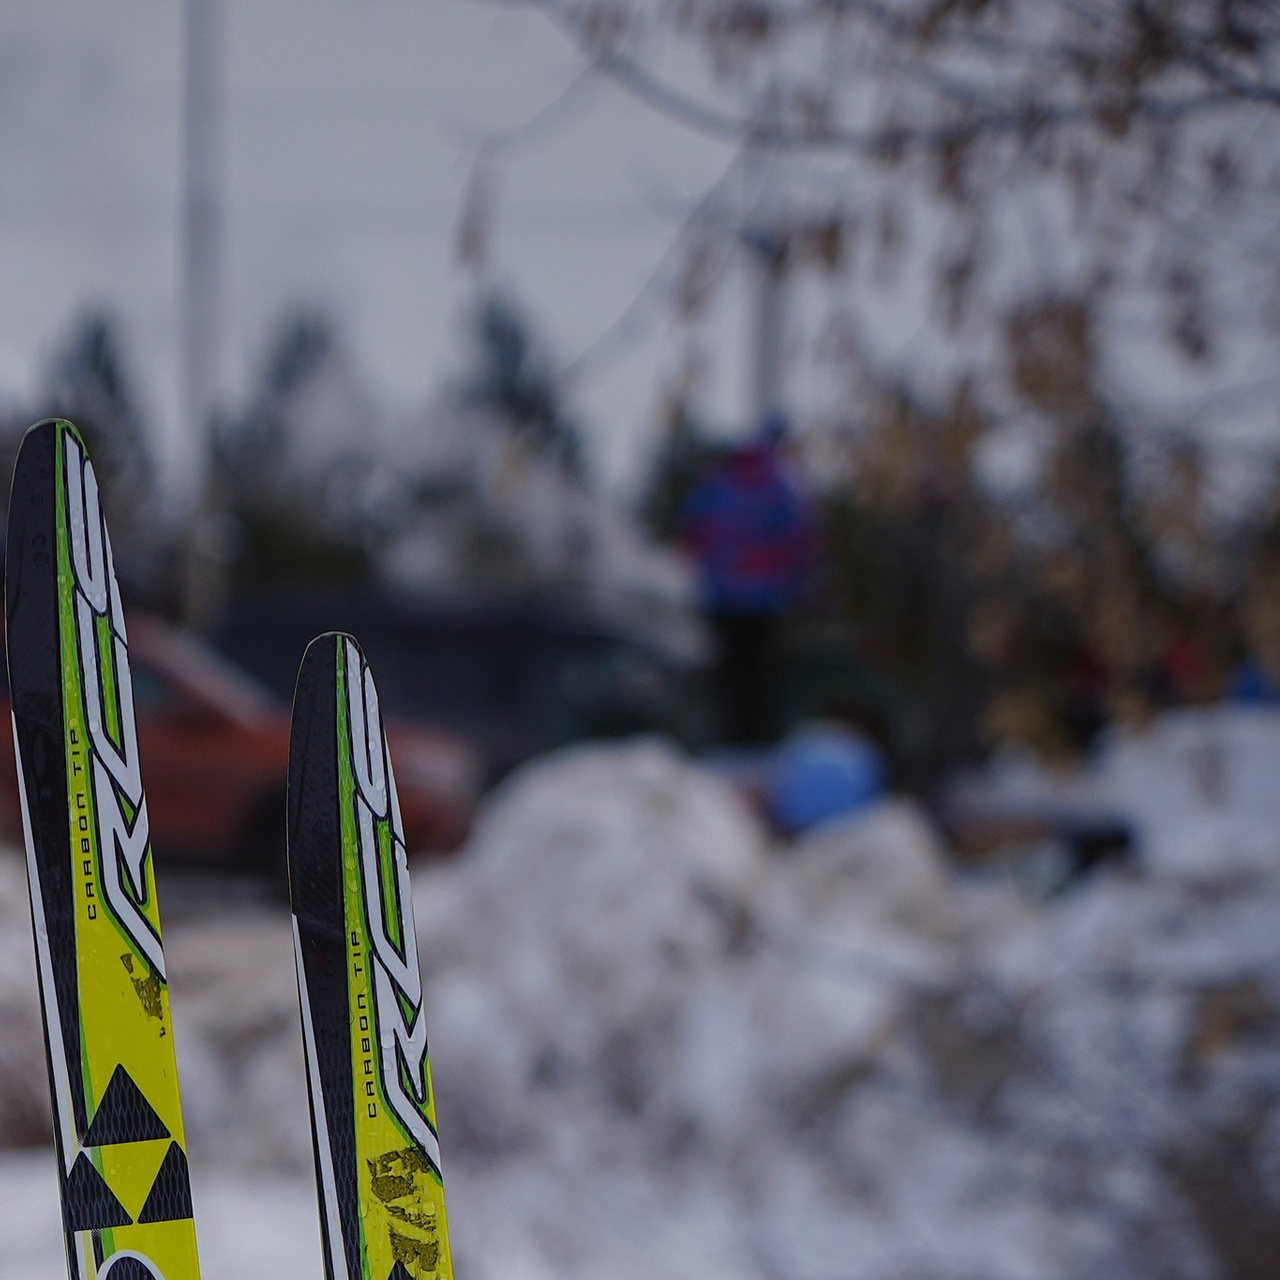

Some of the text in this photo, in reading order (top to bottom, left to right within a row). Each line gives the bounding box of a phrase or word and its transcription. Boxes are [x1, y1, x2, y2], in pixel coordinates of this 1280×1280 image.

[70, 729, 97, 920] CARBON TIP
[351, 931, 378, 1119] CARBON TIP
